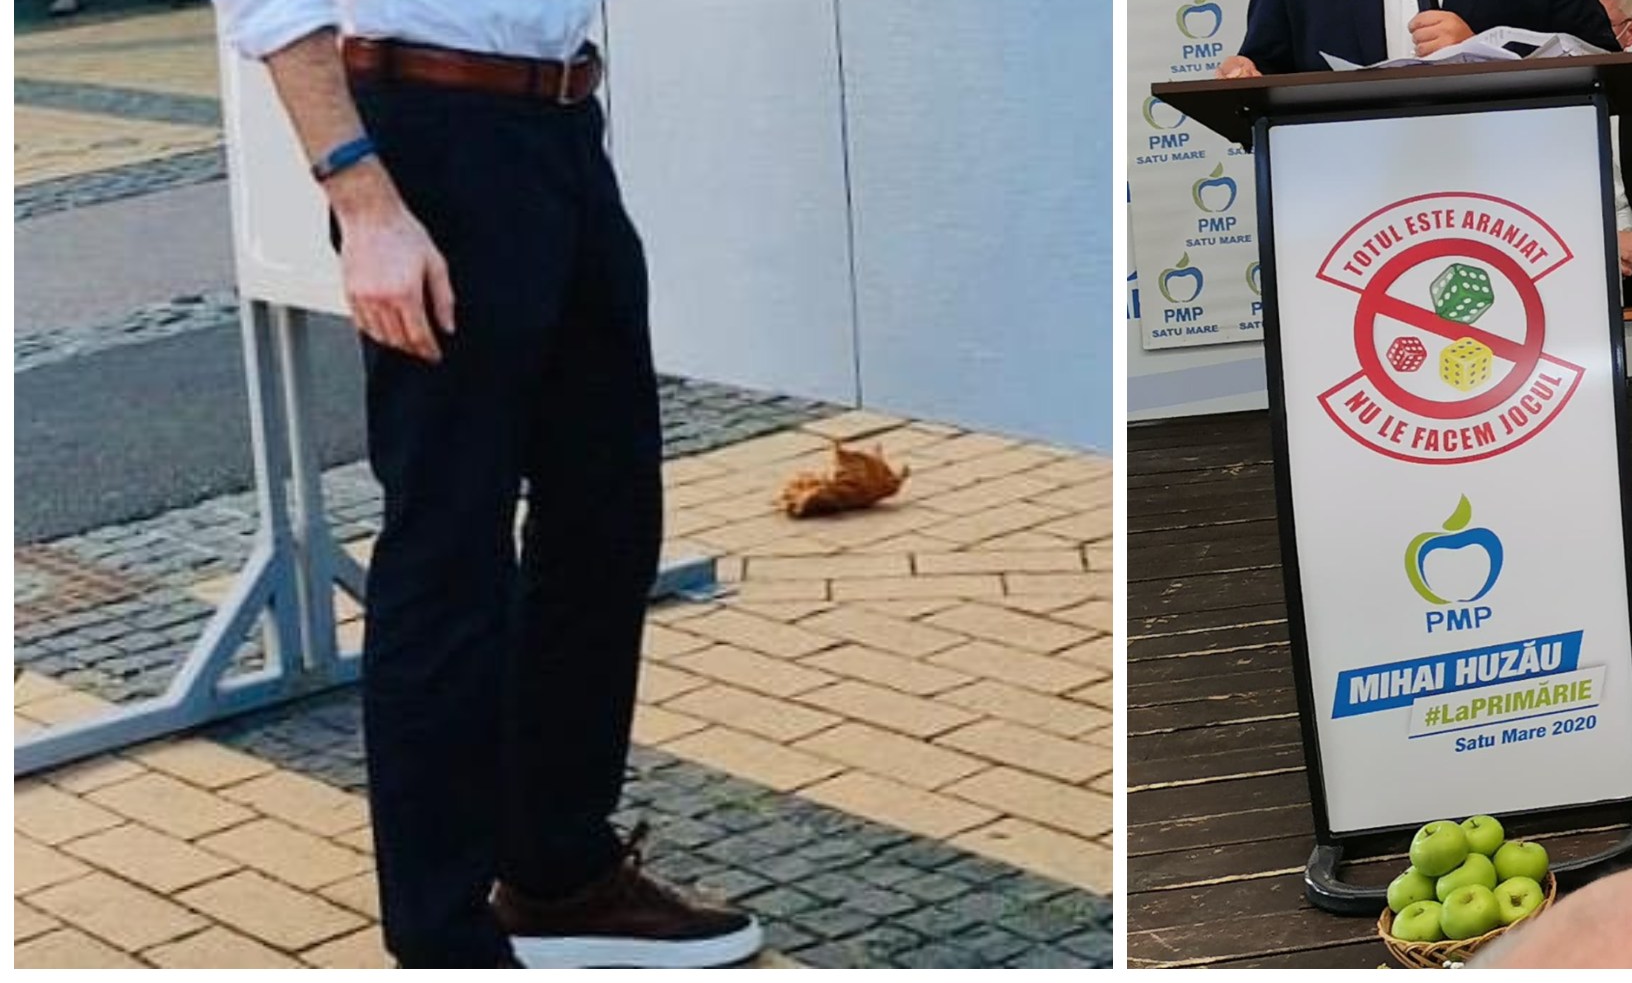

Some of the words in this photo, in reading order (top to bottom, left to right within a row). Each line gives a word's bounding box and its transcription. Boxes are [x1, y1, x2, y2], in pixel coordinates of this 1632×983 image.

[1182, 42, 1223, 60] PMP
[1170, 63, 1203, 74] SATU
[1148, 132, 1190, 150] PMP
[1136, 153, 1168, 165] SATU
[1171, 149, 1206, 161] MARE
[1198, 216, 1237, 233] PMP
[1185, 237, 1217, 248] SATU
[1218, 234, 1252, 245] MARE
[1343, 225, 1403, 276] TOTUL
[1405, 210, 1455, 235] ESTE
[1462, 211, 1549, 264] ARANJAT
[1163, 306, 1204, 324] PMP
[1151, 327, 1183, 338] SATU
[1185, 324, 1219, 335] MARE
[1344, 391, 1382, 424] NU
[1378, 416, 1409, 444] LE
[1412, 422, 1496, 452] FACEM
[1499, 373, 1562, 435] JOCUL
[1426, 607, 1492, 633] PMP
[1349, 663, 1445, 704] MIHAI
[1455, 641, 1562, 687] HUZĂU
[1425, 679, 1592, 726] #LaPRIMĂRIE
[1455, 735, 1494, 752] Satu
[1501, 727, 1546, 744] Mare
[1552, 716, 1597, 735] 2020
